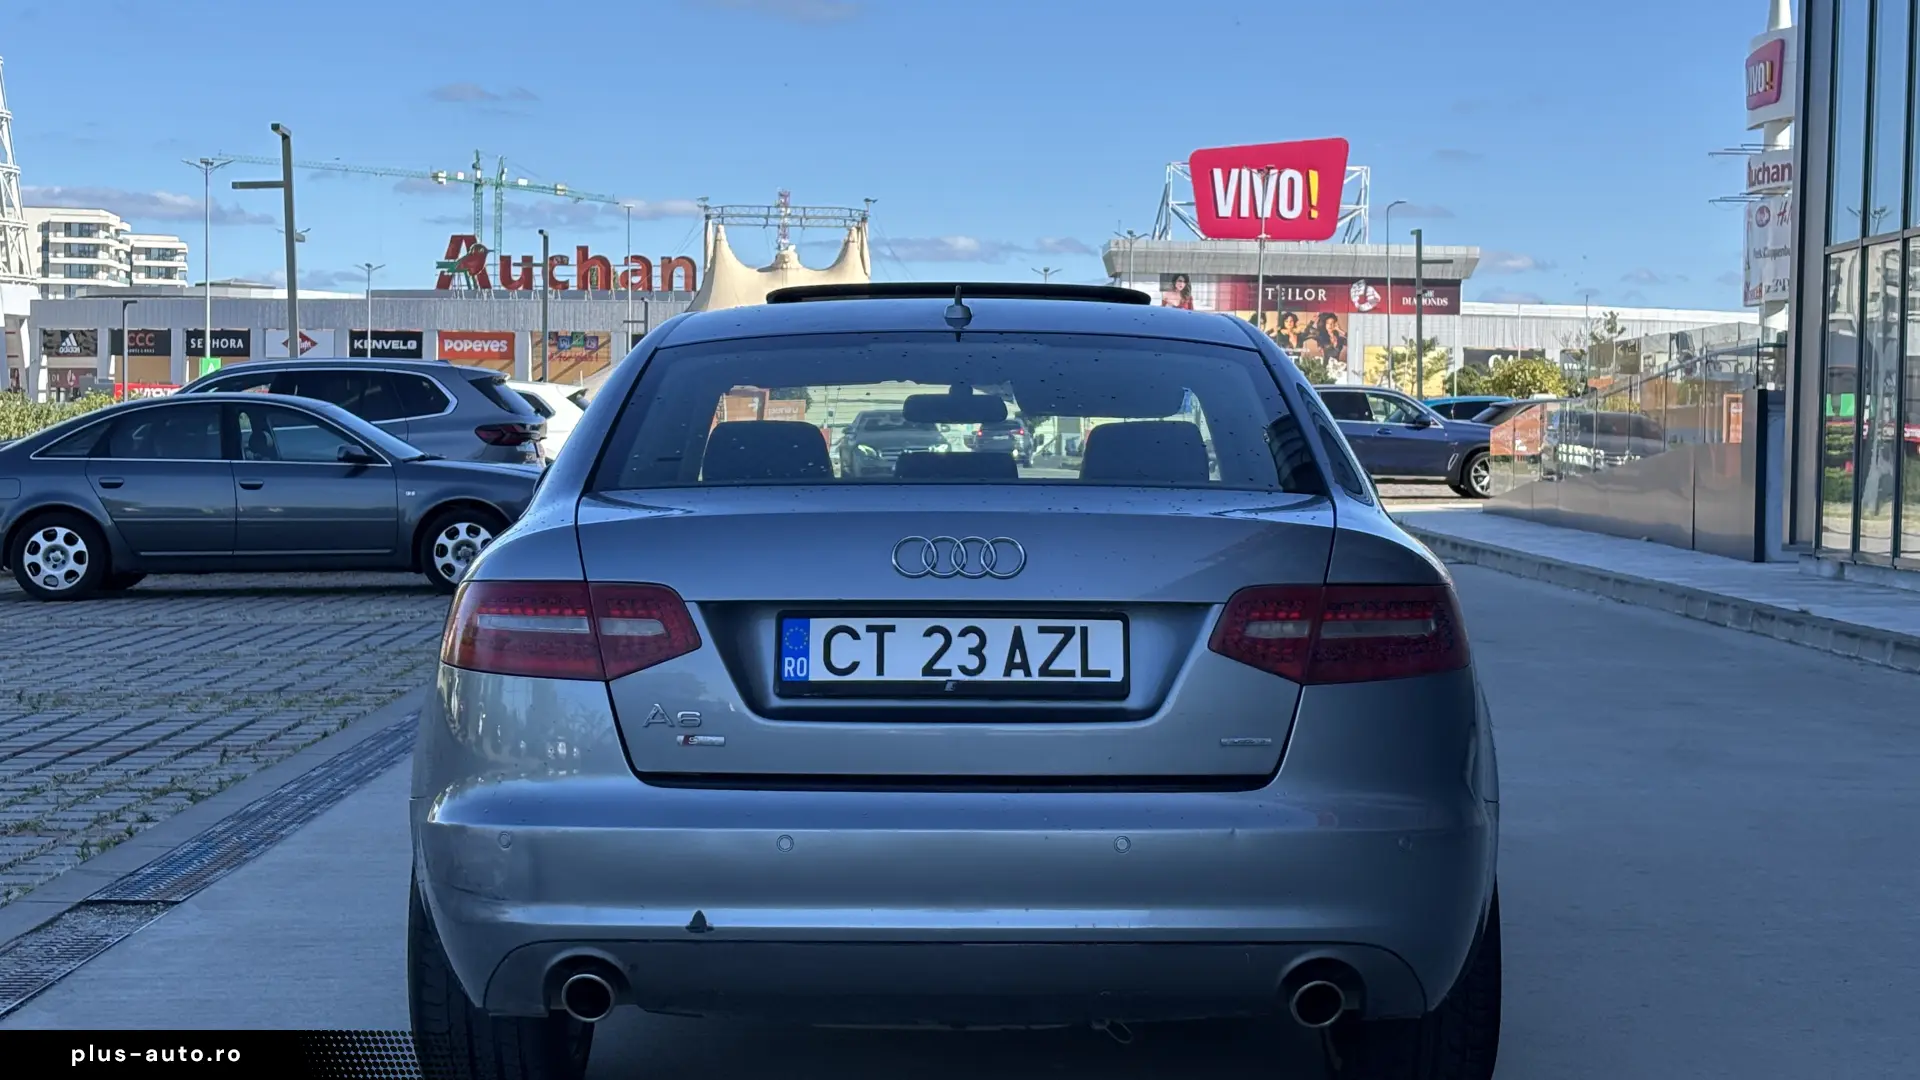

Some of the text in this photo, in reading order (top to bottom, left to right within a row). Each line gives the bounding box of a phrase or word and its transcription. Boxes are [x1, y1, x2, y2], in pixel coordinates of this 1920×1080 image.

[1748, 161, 1793, 187] uchan
[1212, 167, 1319, 220] VIVO!
[436, 234, 697, 292] Auchan
[126, 332, 155, 347] CCC
[190, 338, 244, 349] SEHORA
[822, 624, 1112, 678] CT 23 AZL
[784, 657, 807, 678] RO
[642, 703, 701, 728] A6
